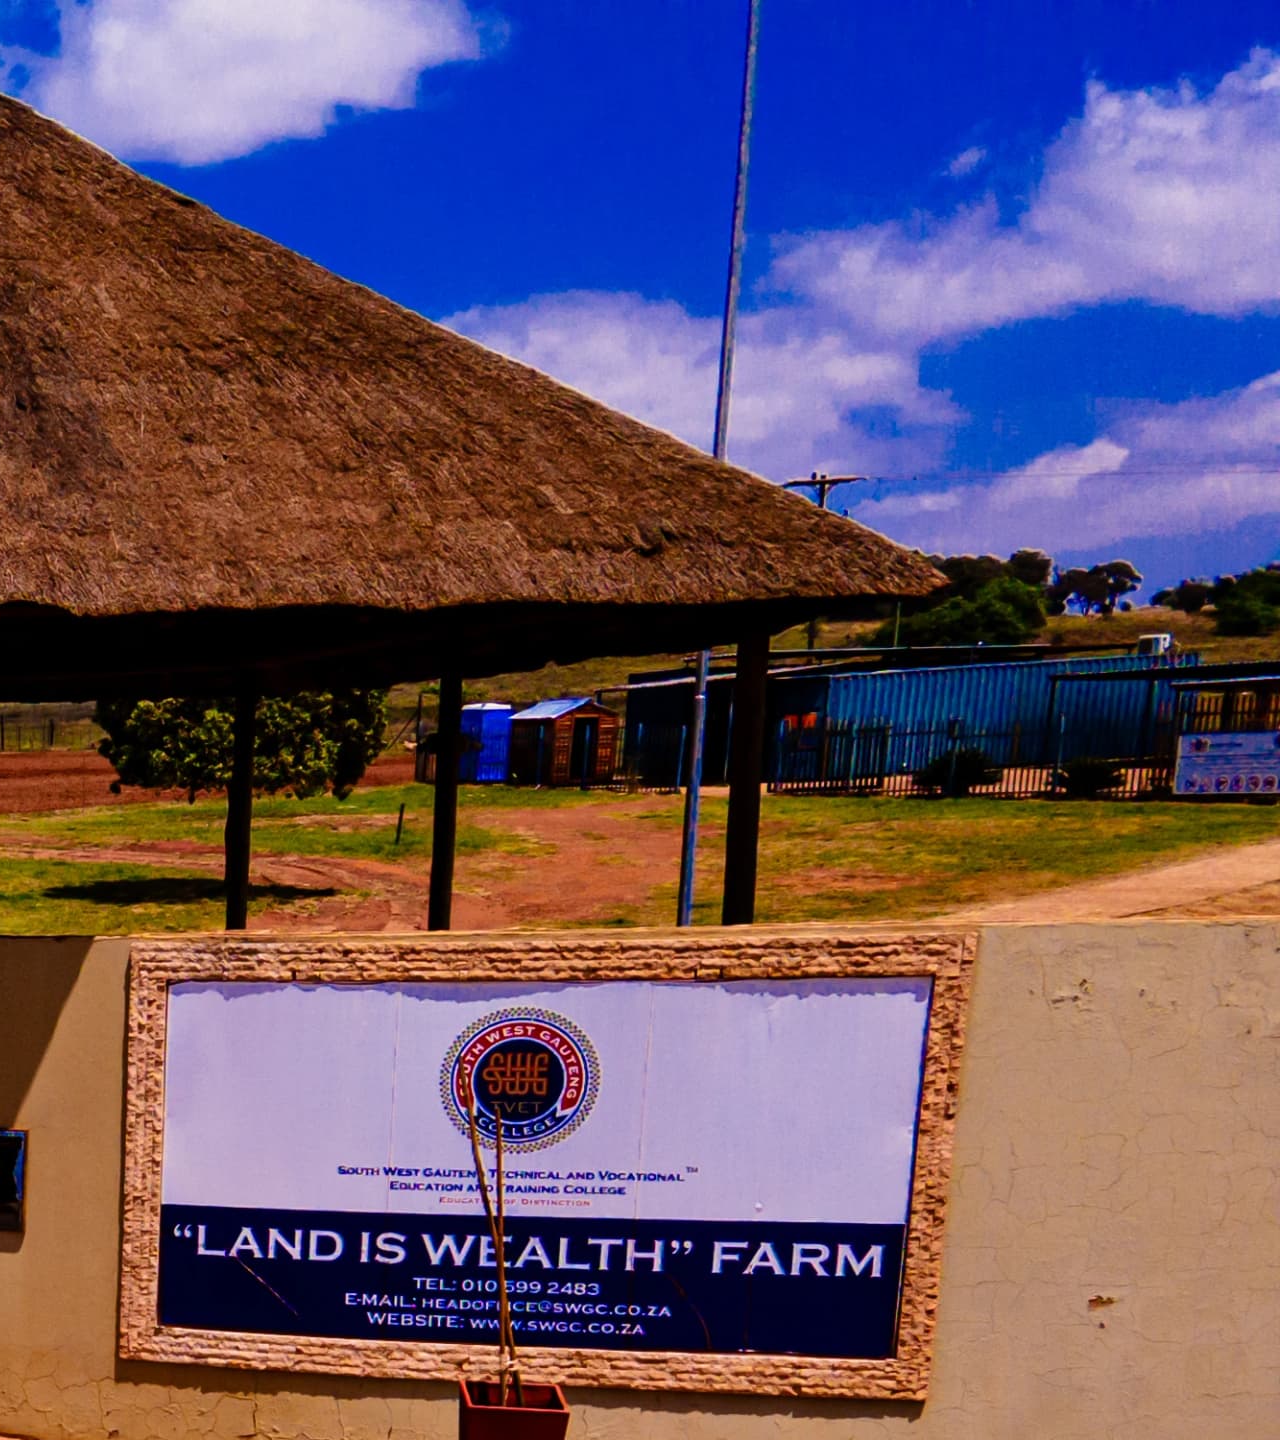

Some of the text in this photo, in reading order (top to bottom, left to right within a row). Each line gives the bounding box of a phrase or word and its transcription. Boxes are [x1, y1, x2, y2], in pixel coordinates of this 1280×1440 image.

[485, 1025, 536, 1044] WEST
[539, 1030, 580, 1099] GAUTENG
[489, 1101, 544, 1114] TVET
[478, 1115, 556, 1137] COLLEGE
[337, 1165, 380, 1176] SOUTH
[383, 1167, 420, 1177] WEST
[422, 1167, 485, 1179] GAUTEN
[488, 1168, 564, 1180] TCHNICAL
[566, 1171, 595, 1180] AND
[598, 1170, 685, 1182] VOCATIONAL
[389, 1180, 463, 1192] EDUCATION
[497, 1182, 560, 1195] RAINING
[563, 1184, 627, 1195] COLLEGE
[359, 1230, 408, 1265] IS
[711, 1240, 887, 1279] FARM
[412, 1277, 601, 1297] TEL: 010 599 2483
[344, 1292, 417, 1308] E-MAIL:
[366, 1311, 465, 1329] WEBSITE:
